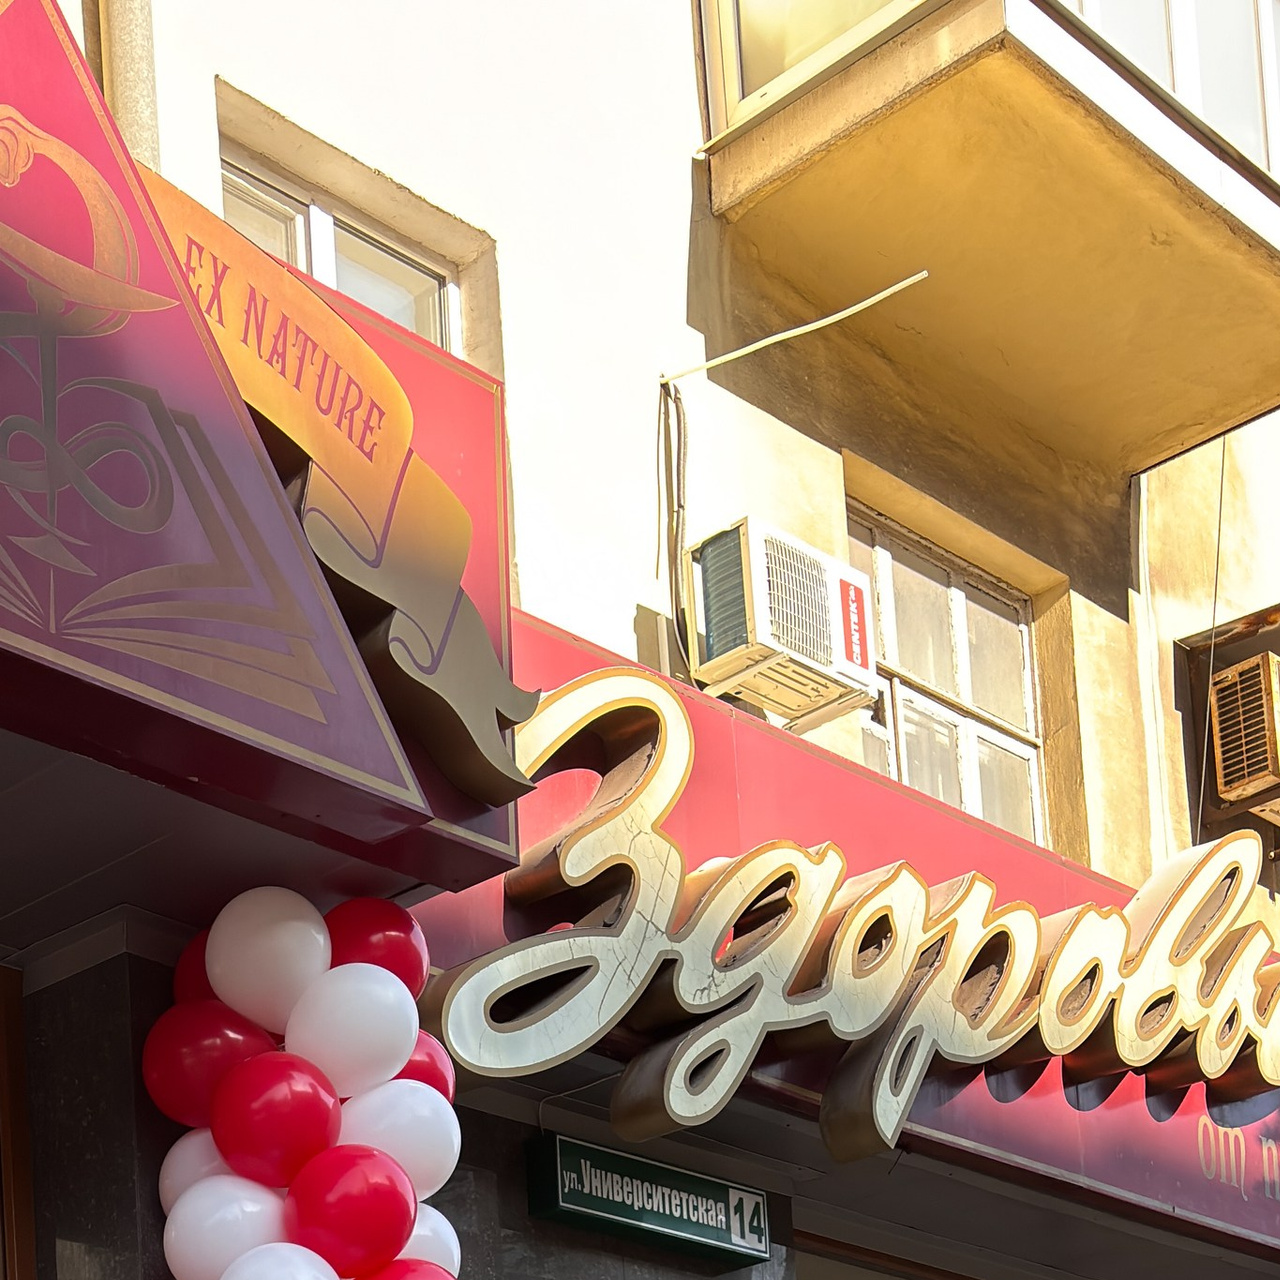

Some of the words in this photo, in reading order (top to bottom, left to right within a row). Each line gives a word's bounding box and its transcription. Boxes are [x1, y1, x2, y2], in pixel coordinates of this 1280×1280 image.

[184, 233, 231, 328] EX
[240, 282, 387, 463] NATURE
[442, 666, 1280, 1150] Здоровь
[733, 1196, 765, 1244] 14
